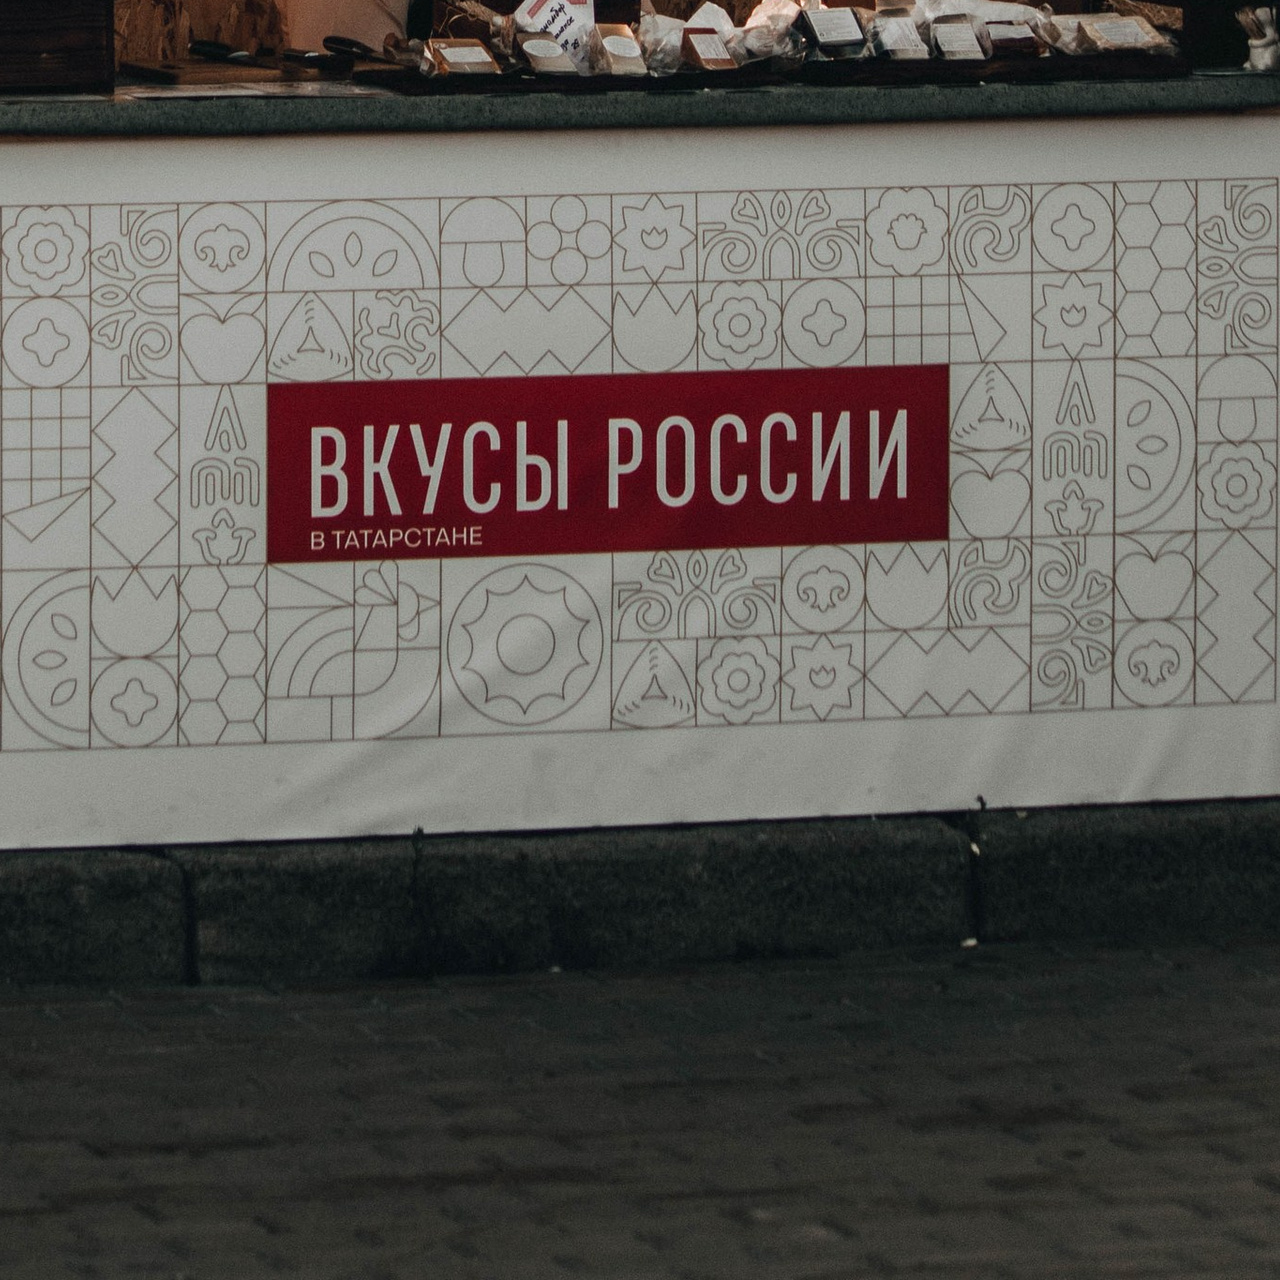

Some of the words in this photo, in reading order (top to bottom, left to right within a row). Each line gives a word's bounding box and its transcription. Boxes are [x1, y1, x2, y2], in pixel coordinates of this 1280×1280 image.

[310, 419, 568, 518] ВКУСЫ
[608, 409, 908, 509] РОССИИ
[310, 531, 325, 550] В
[331, 526, 483, 550] ТАТАРСТАНЕ
